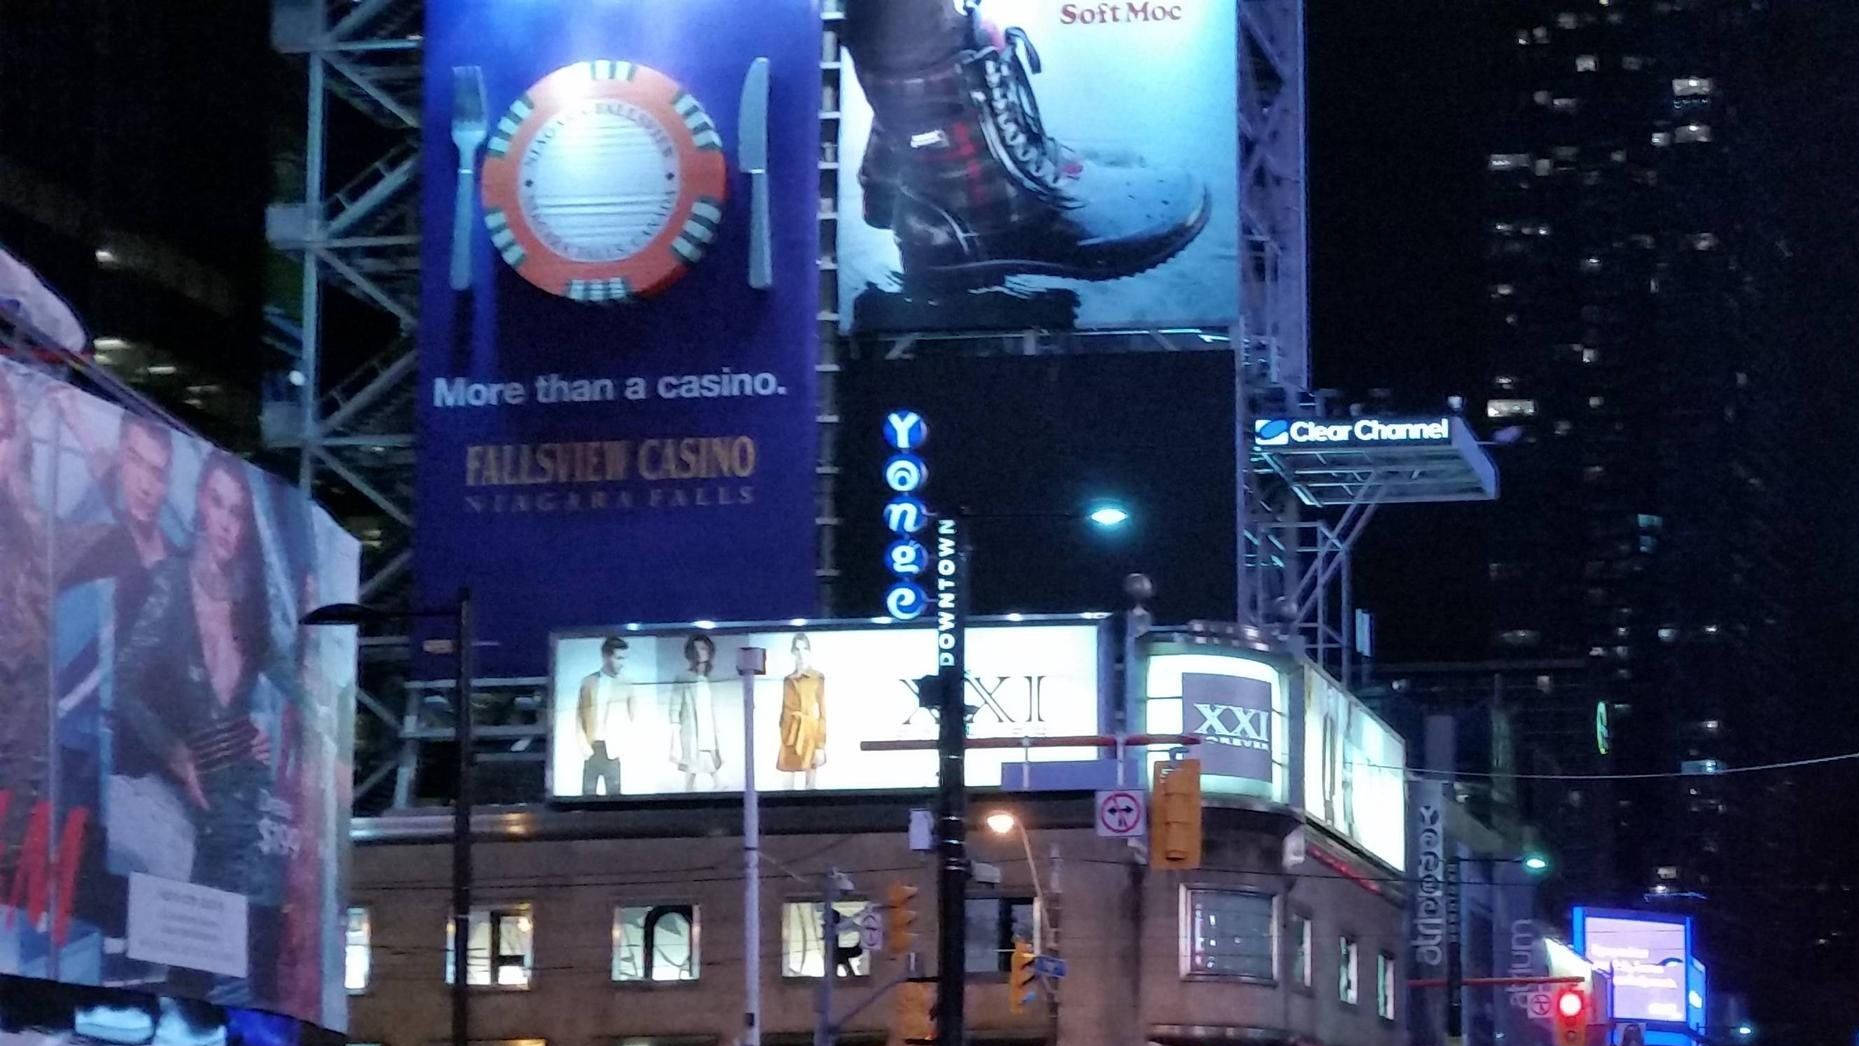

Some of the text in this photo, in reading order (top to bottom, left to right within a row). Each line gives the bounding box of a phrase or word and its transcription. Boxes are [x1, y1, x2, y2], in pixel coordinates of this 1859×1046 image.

[433, 367, 787, 408] More than a casino.
[1290, 418, 1449, 442] Clear Channel
[466, 435, 757, 486] FALLSVIEW CASINO
[464, 486, 756, 513] NIAGARA FALLS
[938, 519, 957, 667] DOWNTOWN
[1193, 702, 1271, 741] XXI
